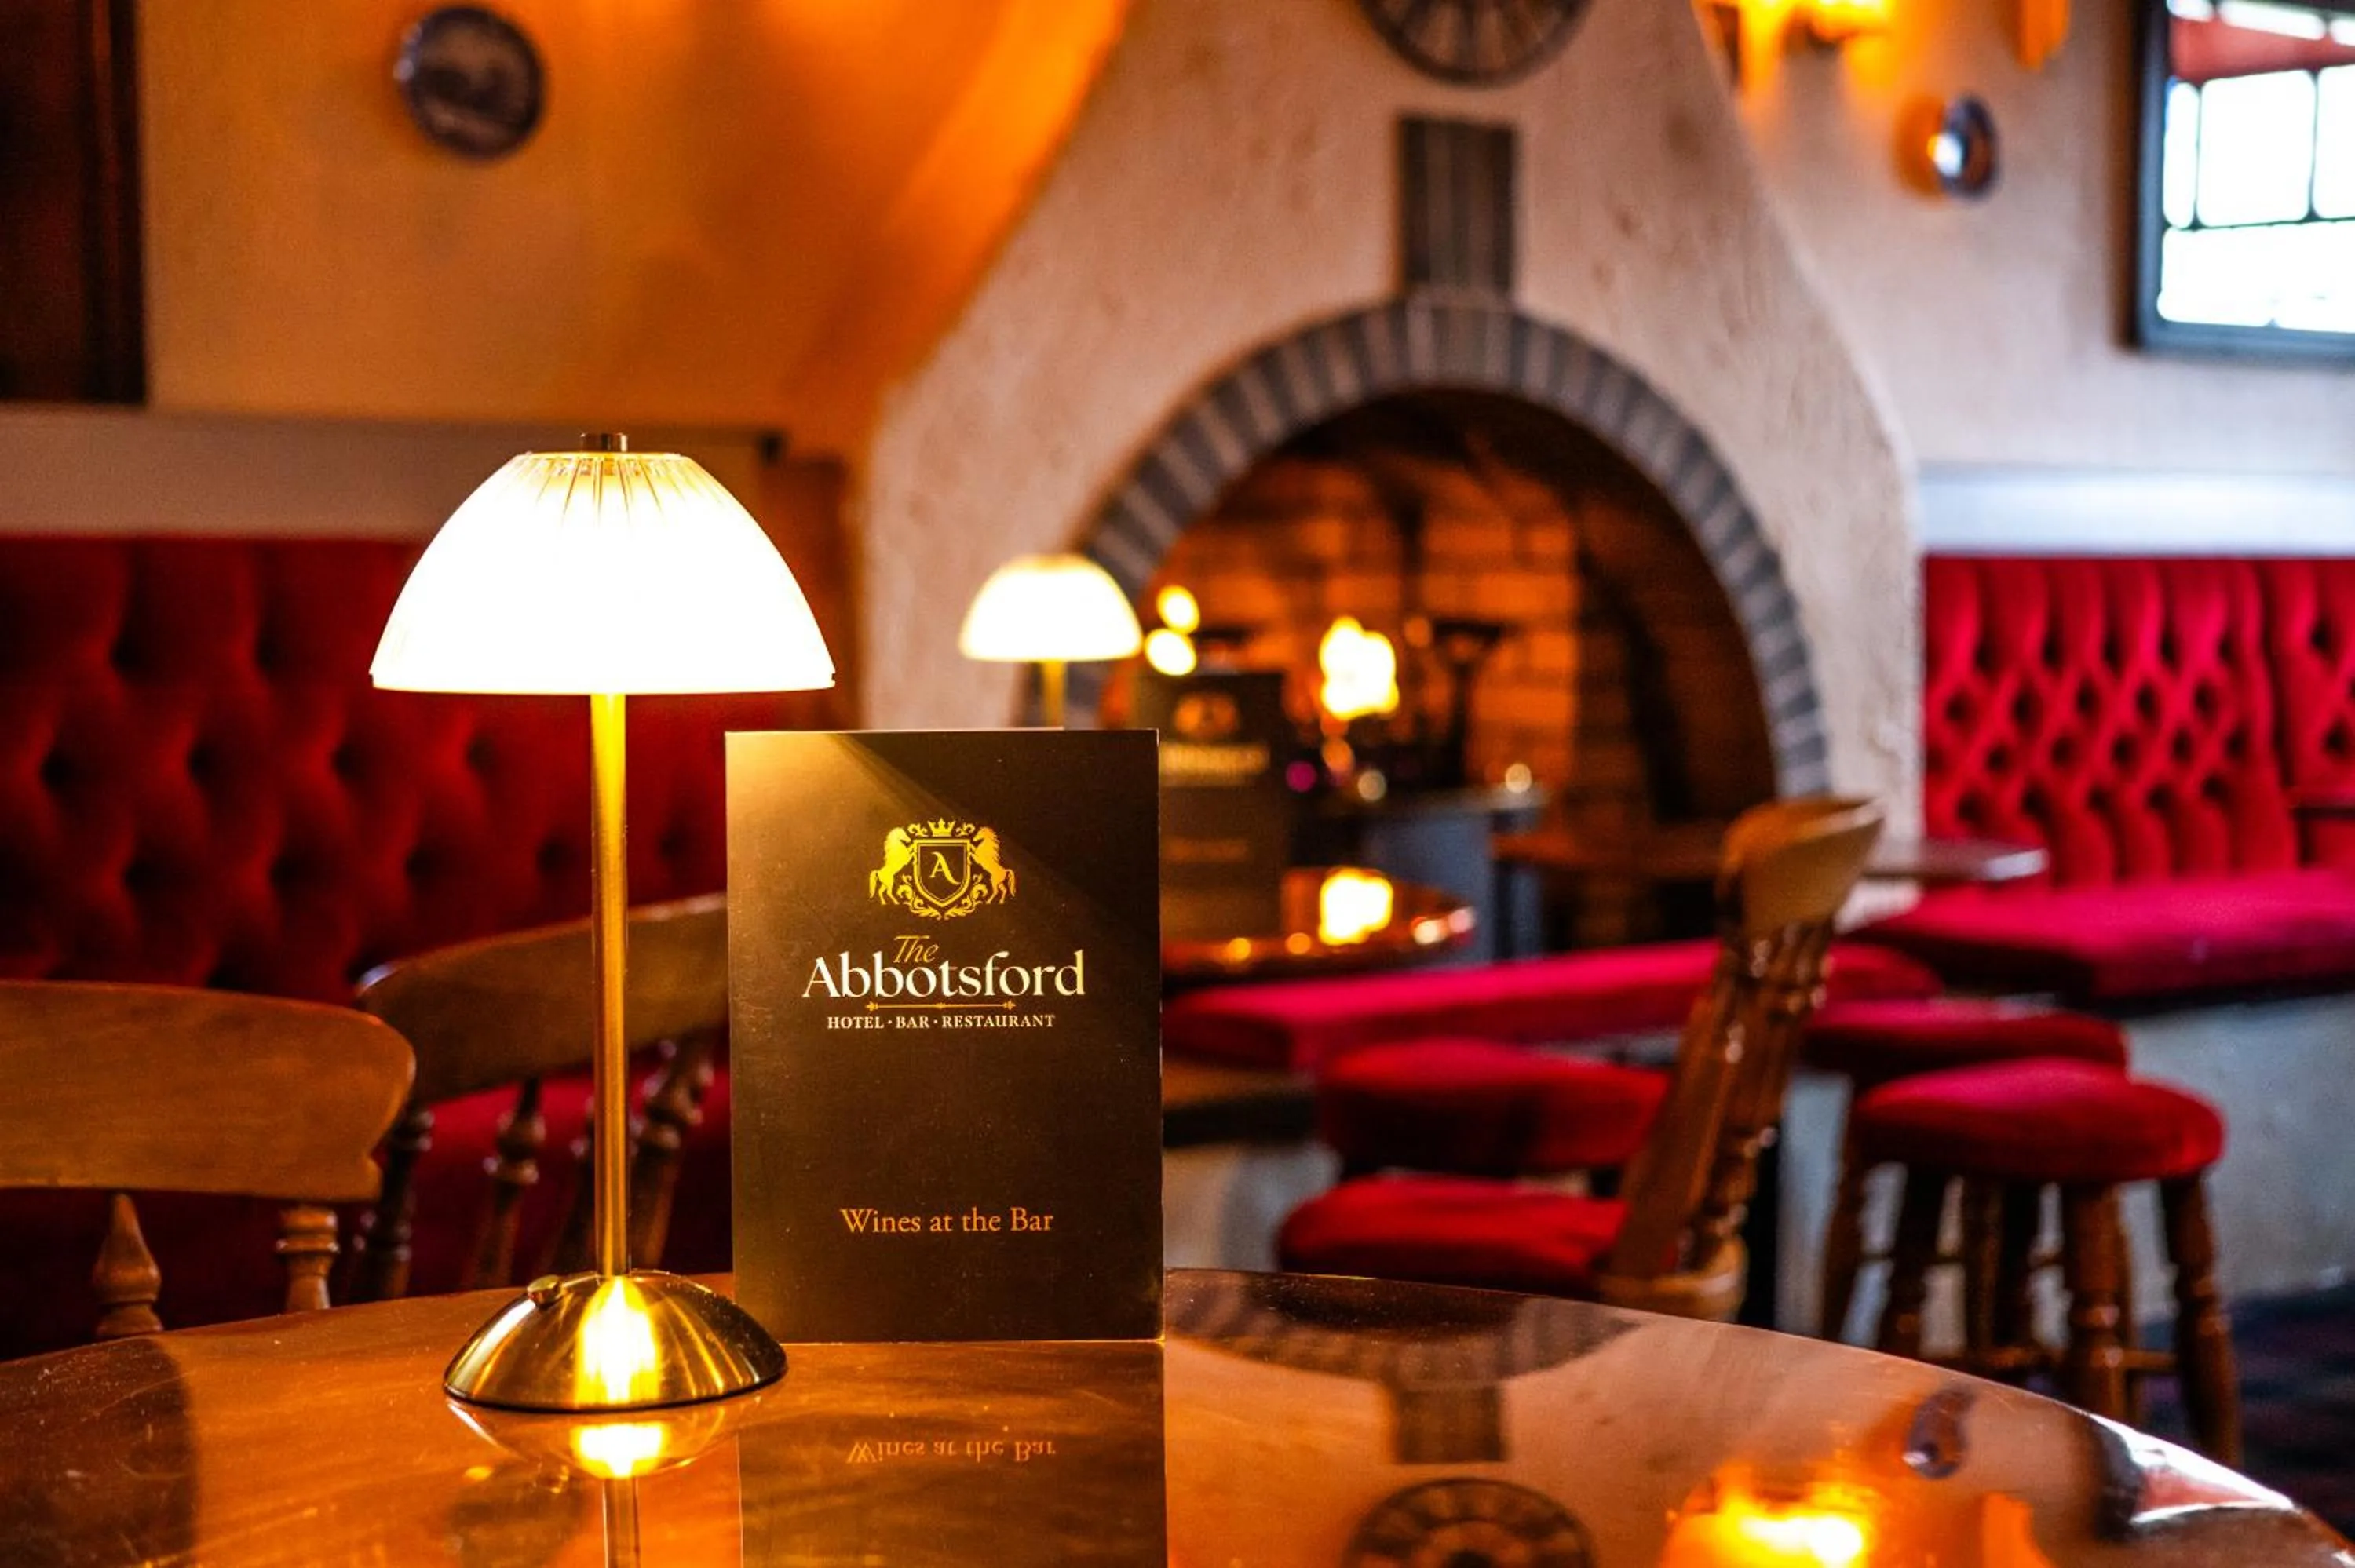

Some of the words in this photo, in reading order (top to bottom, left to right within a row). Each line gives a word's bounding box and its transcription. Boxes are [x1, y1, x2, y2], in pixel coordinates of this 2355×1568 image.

[929, 851, 961, 885] A
[894, 935, 939, 964] The
[802, 949, 1086, 998] Abbotsford
[827, 1016, 885, 1030] HOTEL
[896, 1016, 930, 1029] BAR
[942, 1015, 1055, 1028] RESTAURANT
[840, 1208, 921, 1234] Wines
[930, 1212, 953, 1231] at
[962, 1207, 1001, 1231] the
[1010, 1208, 1053, 1231] Bar
